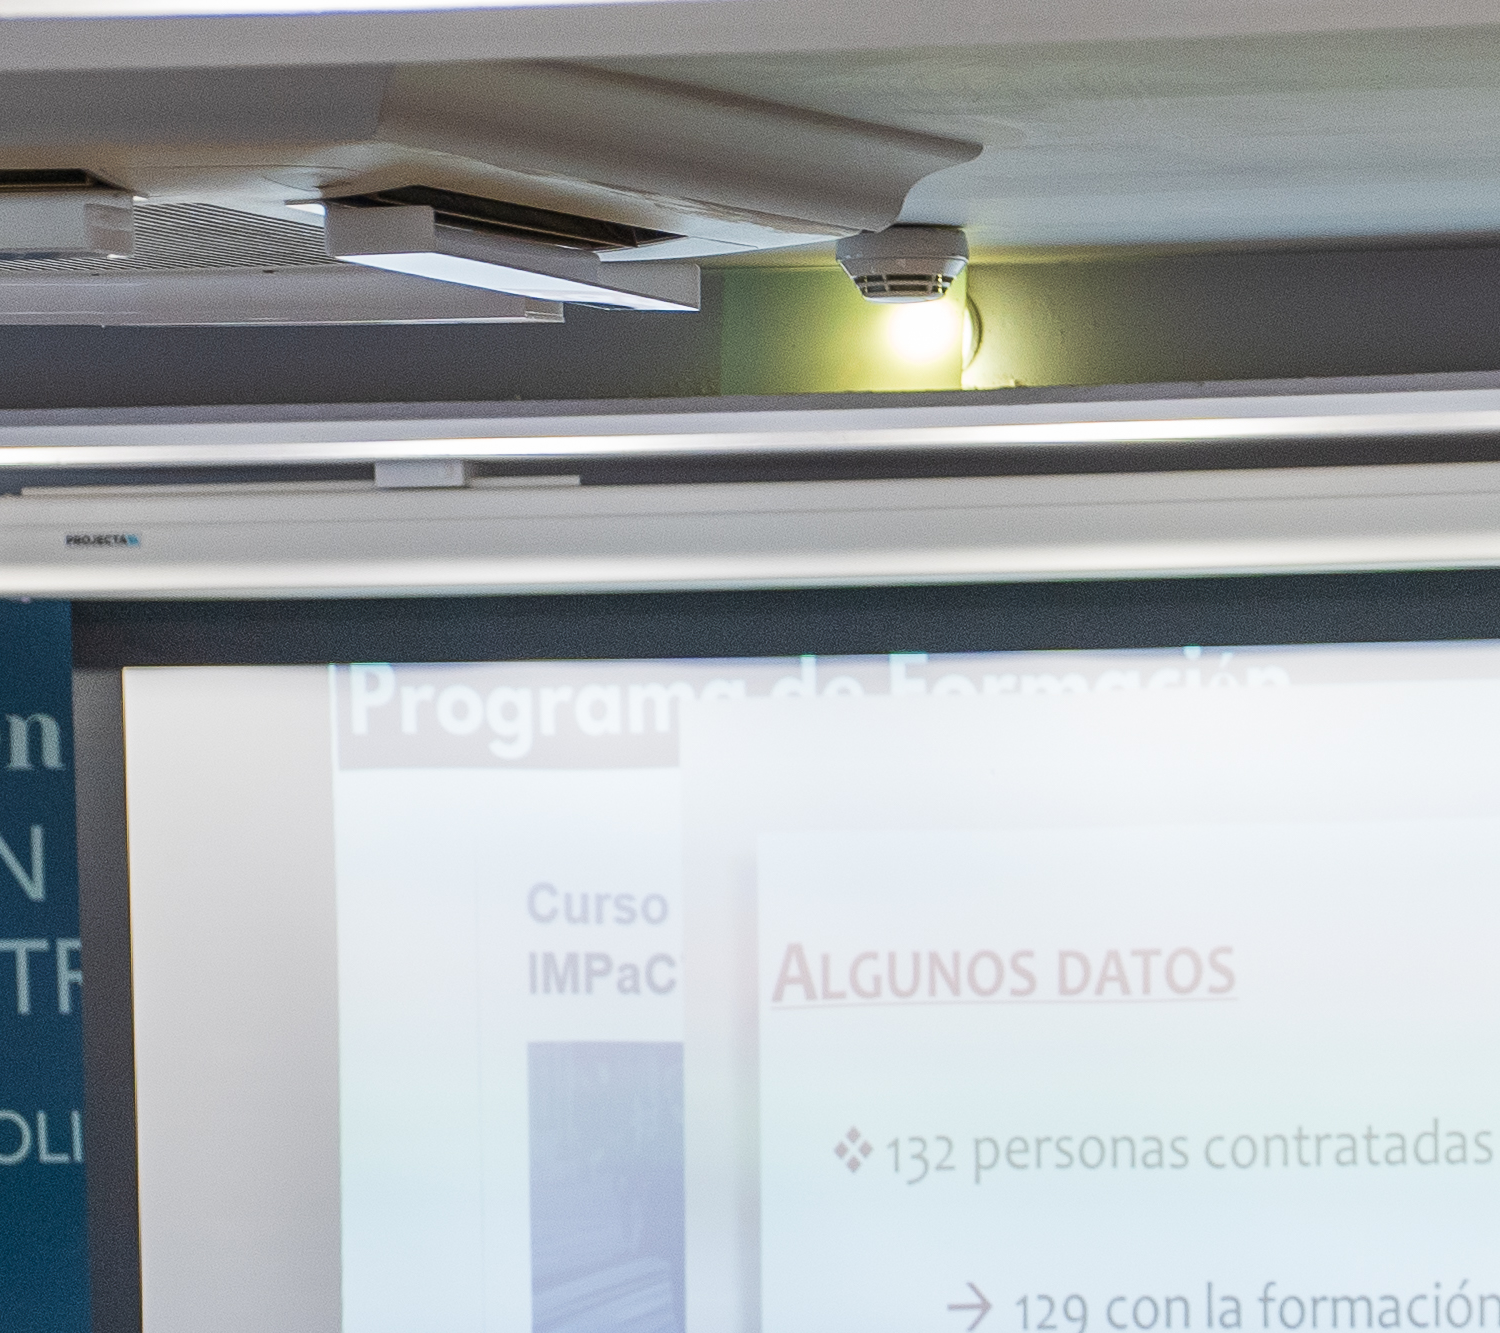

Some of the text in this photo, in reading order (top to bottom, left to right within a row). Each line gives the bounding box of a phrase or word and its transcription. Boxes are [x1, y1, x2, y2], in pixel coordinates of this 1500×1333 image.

[66, 534, 127, 545] PROJECTA
[526, 881, 669, 927] Curso
[526, 951, 684, 999] IMPaC
[771, 940, 1237, 1005] ALGUNOS DATOS
[886, 1134, 956, 1187] 132
[973, 1134, 1190, 1186] personas
[1203, 1116, 1494, 1171] contratadas
[1105, 1294, 1191, 1332] con
[1205, 1280, 1243, 1331] la
